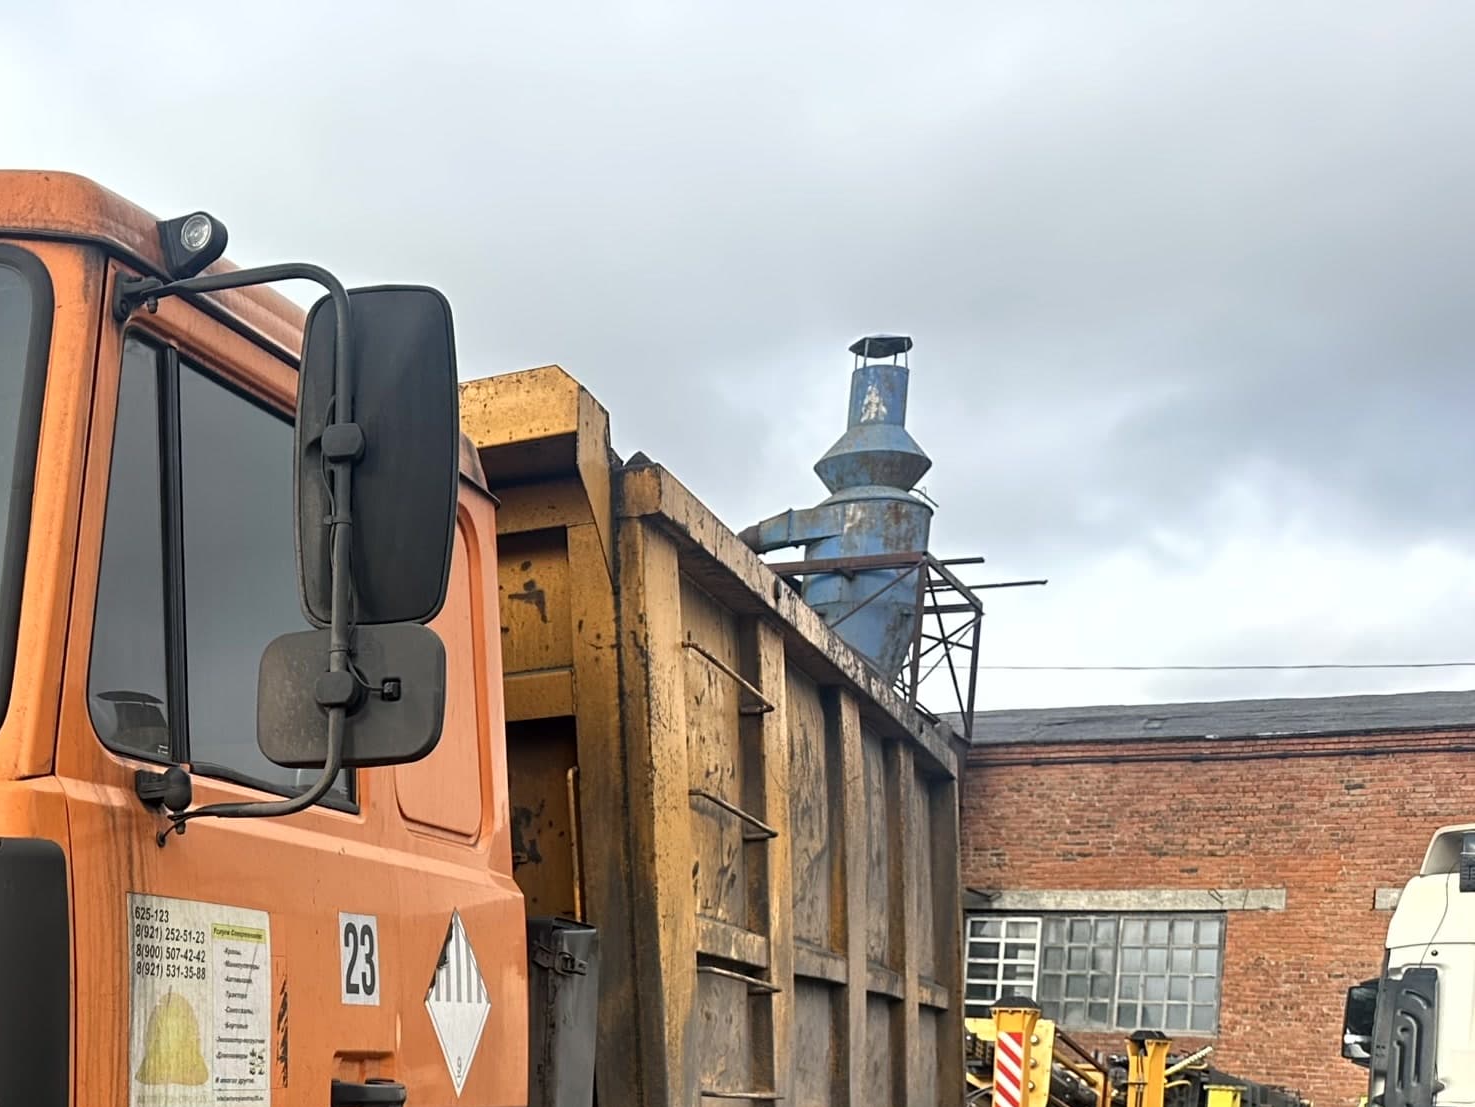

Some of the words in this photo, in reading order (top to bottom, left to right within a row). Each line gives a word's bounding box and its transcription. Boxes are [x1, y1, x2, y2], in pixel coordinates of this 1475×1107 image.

[134, 906, 170, 923] 625-123
[135, 924, 163, 943] 8(921)
[165, 928, 206, 945] 252-51-23
[135, 943, 164, 961] 8(900)
[165, 946, 206, 963] 507-42-42
[344, 921, 376, 996] 23
[136, 961, 164, 979] 8(921)
[165, 964, 206, 981] 531-35-88
